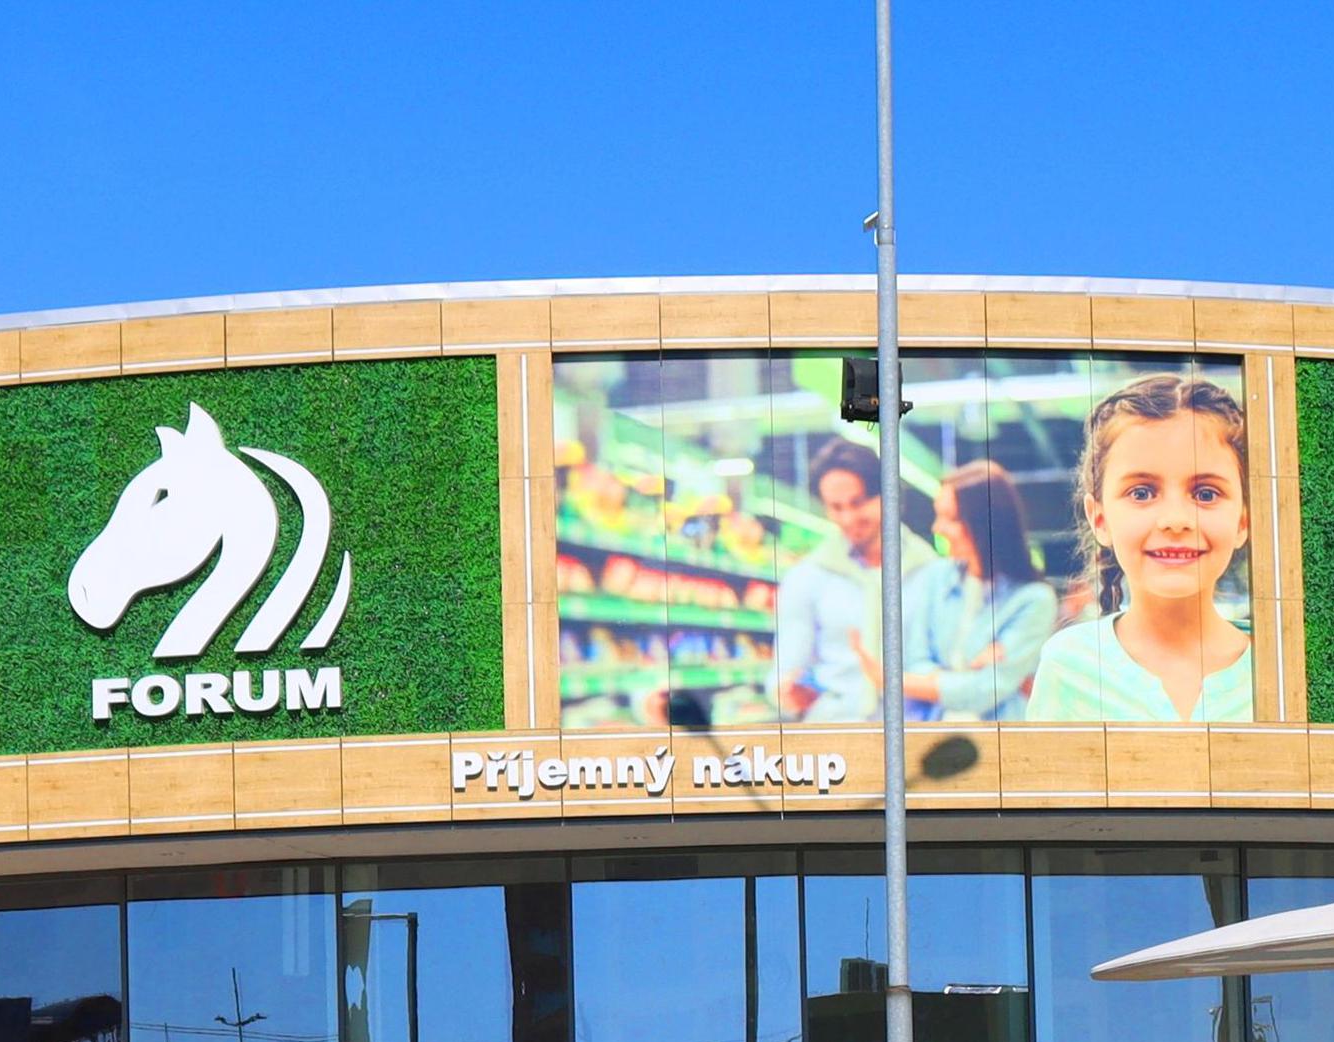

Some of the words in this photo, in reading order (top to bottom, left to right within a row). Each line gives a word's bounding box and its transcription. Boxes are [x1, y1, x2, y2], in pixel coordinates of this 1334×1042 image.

[92, 667, 342, 720] FORUM
[452, 746, 675, 797] Příjemný
[693, 744, 847, 790] nákup
